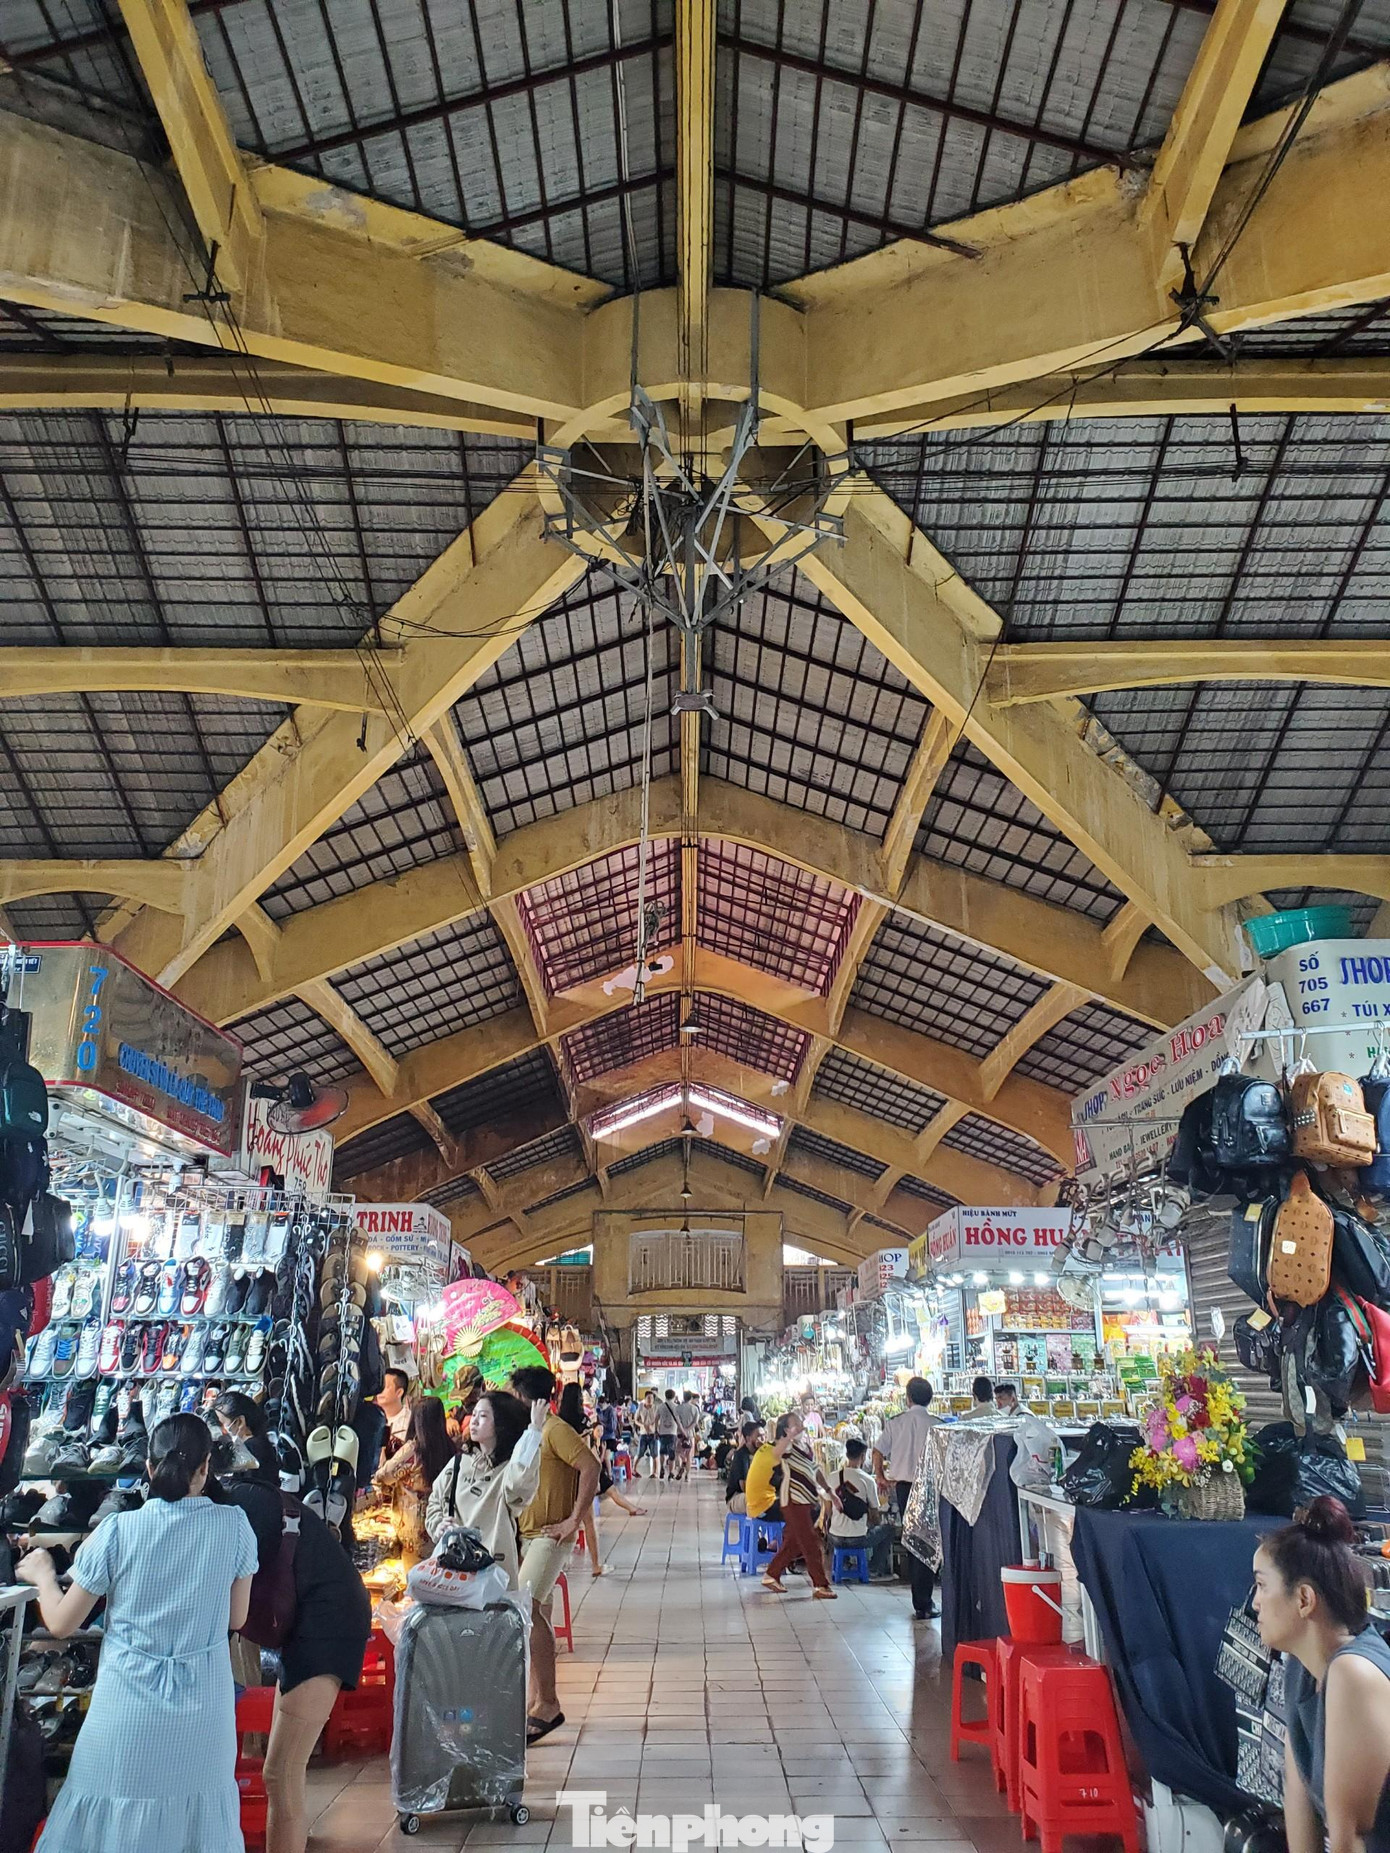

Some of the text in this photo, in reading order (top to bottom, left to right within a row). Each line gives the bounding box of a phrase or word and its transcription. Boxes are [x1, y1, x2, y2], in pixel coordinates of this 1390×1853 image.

[1299, 951, 1320, 972] SỐ
[1299, 977, 1329, 994] 705
[1302, 998, 1330, 1015] 667
[1352, 1000, 1378, 1018] TÚI
[1169, 1014, 1224, 1064] Hoa
[965, 1217, 1028, 1246] HỒNG
[1079, 1787, 1099, 1799] 710
